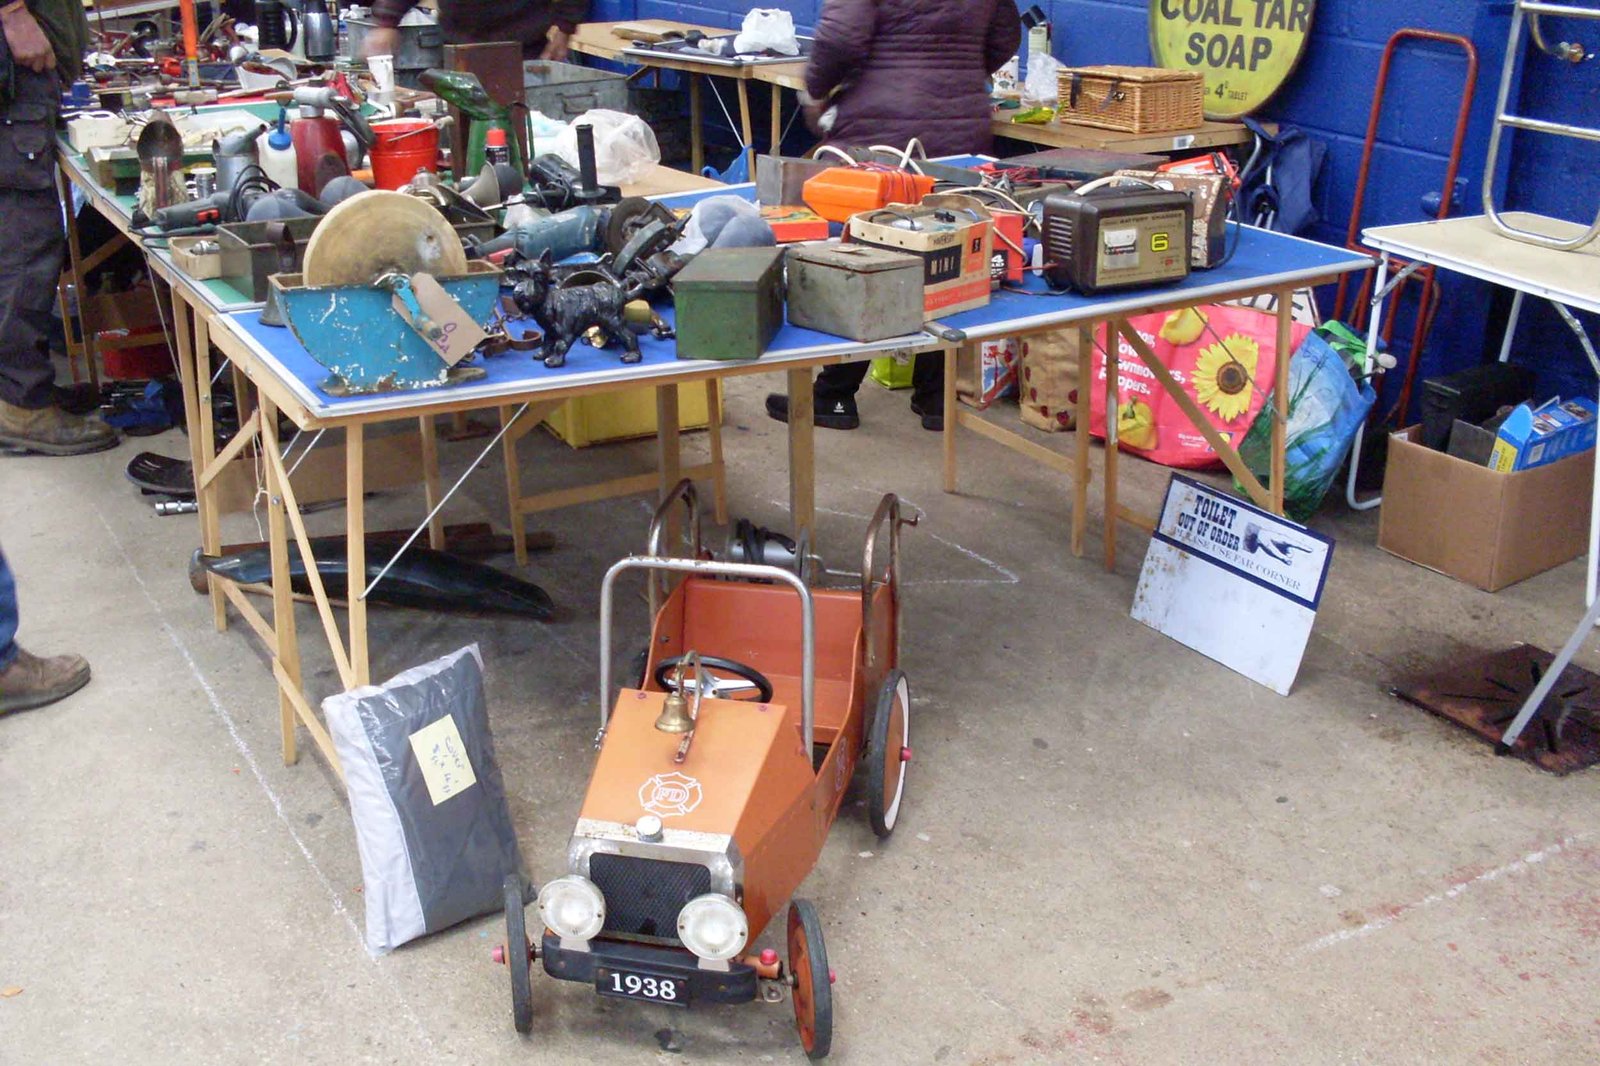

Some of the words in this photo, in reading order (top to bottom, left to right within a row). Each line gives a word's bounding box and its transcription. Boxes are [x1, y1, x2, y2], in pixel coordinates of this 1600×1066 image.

[1160, 0, 1243, 27] COAL
[1254, 0, 1309, 33] TAR
[1185, 32, 1273, 72] SOAP
[1194, 494, 1237, 529] TOILET
[1178, 511, 1197, 532] OUT
[1197, 520, 1210, 537] OF
[1210, 526, 1240, 551] ORDER
[1212, 543, 1232, 559] USE
[1233, 553, 1255, 570] FAR
[1256, 563, 1301, 591] CORNER
[656, 787, 686, 803] FD
[610, 973, 677, 1000] 1938
